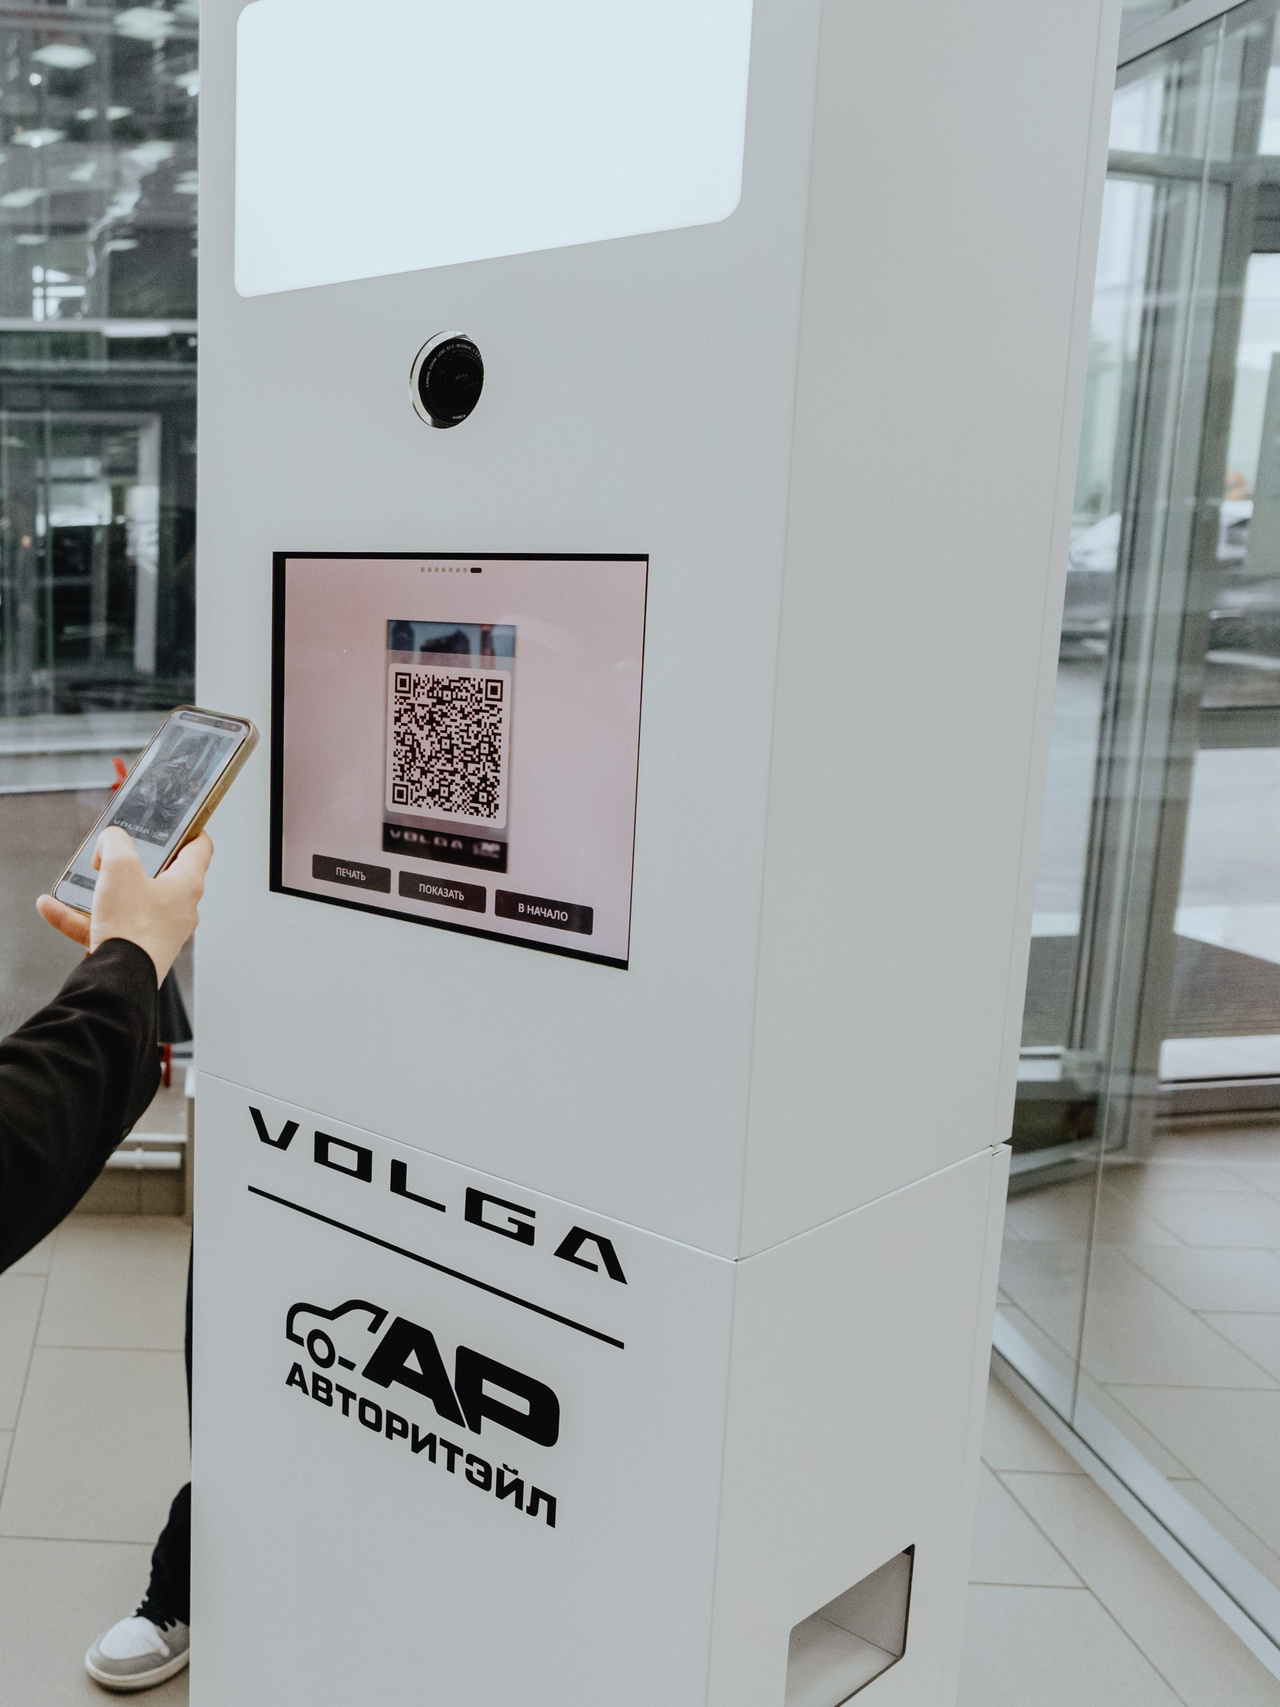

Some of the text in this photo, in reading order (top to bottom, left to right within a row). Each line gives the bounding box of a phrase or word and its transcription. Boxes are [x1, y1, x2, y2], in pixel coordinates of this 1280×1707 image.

[113, 819, 150, 835] VOLGA
[389, 828, 463, 850] VOLGA
[335, 866, 366, 881] ПЕЧАТЬ
[418, 883, 465, 901] ПОКАЗАТЬ
[518, 902, 569, 922] В НАЧАЛО
[248, 1105, 628, 1285] VOLGA
[285, 1361, 557, 1529] АВТОРИТЭЙЛ
